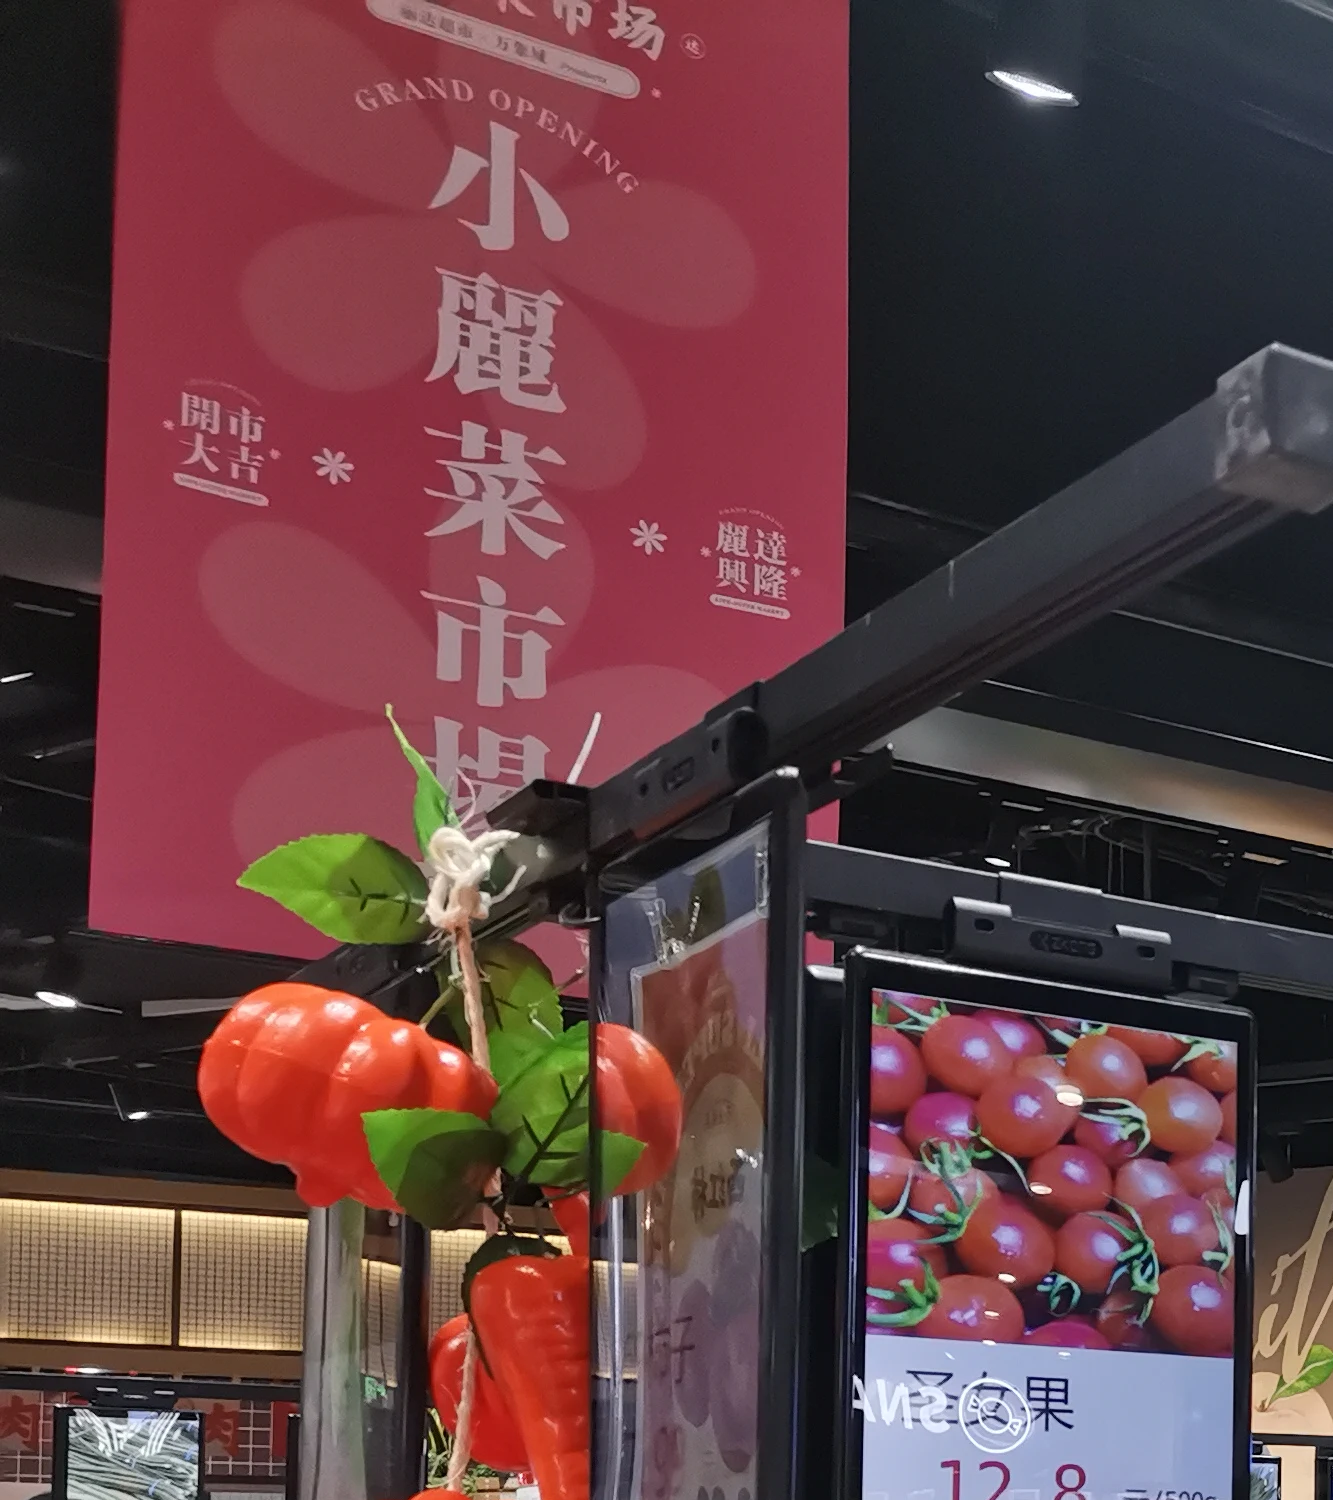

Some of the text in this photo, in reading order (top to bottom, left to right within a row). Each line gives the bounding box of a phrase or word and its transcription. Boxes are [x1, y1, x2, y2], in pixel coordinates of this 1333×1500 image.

[497, 0, 666, 60] 市场
[355, 77, 640, 194] GRAND OPENING
[180, 391, 266, 443] 開市
[179, 432, 265, 484] 大吉
[716, 521, 787, 566] 麗達
[716, 557, 788, 600] 興隆
[901, 1369, 1074, 1432] 圣女果
